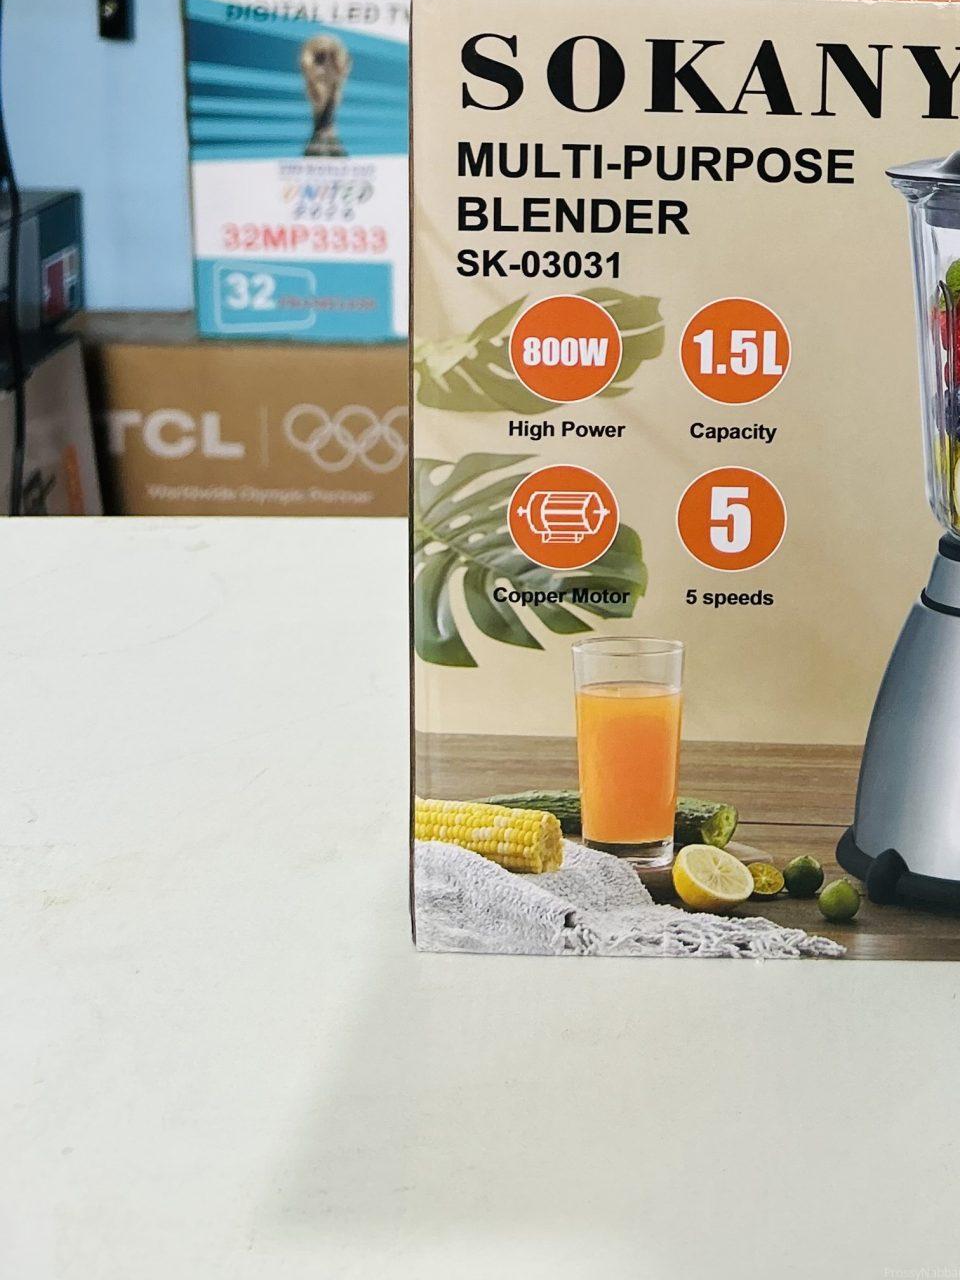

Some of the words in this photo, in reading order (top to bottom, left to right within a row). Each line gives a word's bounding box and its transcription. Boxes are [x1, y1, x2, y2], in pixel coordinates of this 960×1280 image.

[225, 0, 320, 24] DIGITAL
[331, 1, 381, 24] LED
[457, 141, 855, 185] MULTI-PURPOSE
[457, 196, 691, 236] BLENDER
[223, 222, 389, 254] 32MP3333
[456, 248, 621, 280] SK-03031
[225, 272, 277, 310] 32
[522, 335, 609, 368] 800W
[692, 328, 784, 377] 1.5L
[106, 407, 246, 460] TCL
[508, 420, 555, 441] High
[561, 421, 626, 439] Power
[689, 422, 778, 444] Capacity
[709, 486, 753, 554] 5
[492, 586, 567, 606] Copper
[571, 587, 631, 605] Motor
[685, 589, 698, 606] 5
[702, 589, 775, 608] speeds
